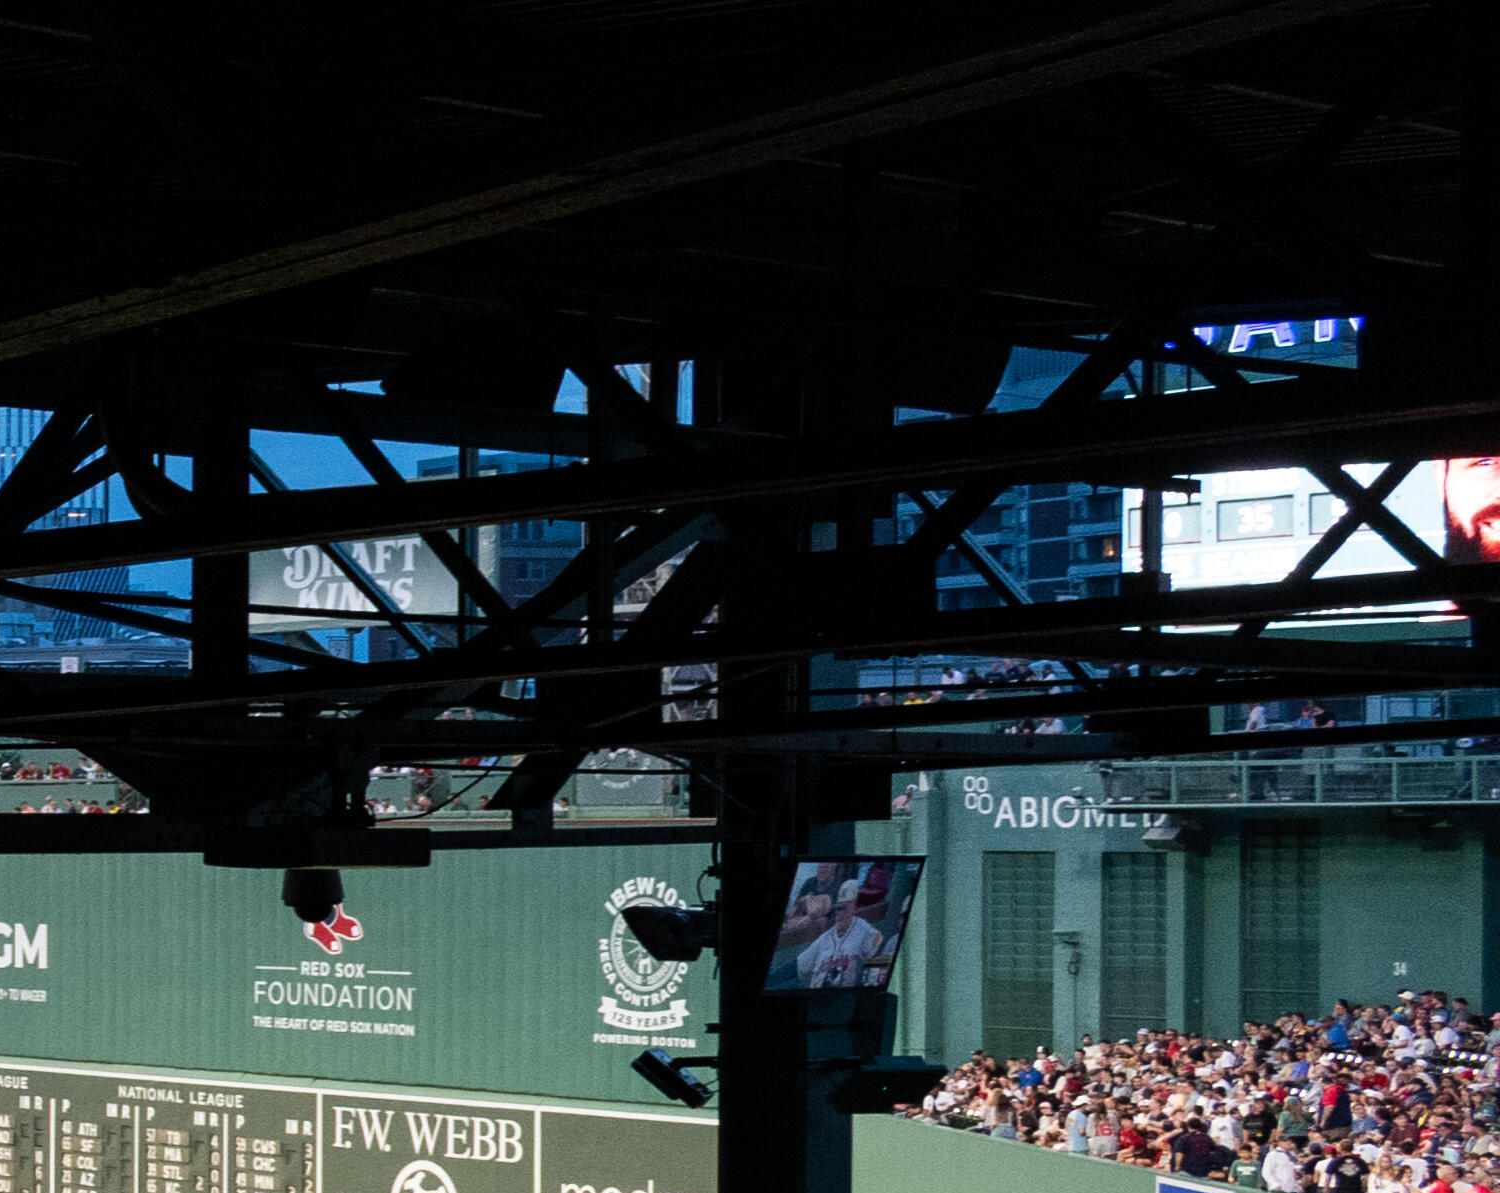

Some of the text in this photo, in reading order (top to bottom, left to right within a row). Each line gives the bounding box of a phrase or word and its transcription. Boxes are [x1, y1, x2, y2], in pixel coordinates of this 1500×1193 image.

[1238, 503, 1273, 534] 35
[300, 961, 366, 979] RED SOX
[599, 938, 618, 986] NECA
[253, 980, 414, 1011] FOUNDATION
[252, 1015, 416, 1037] THE HEART OF RED SOX NATION
[612, 1011, 678, 1028] 125 YEARS
[593, 1033, 697, 1049] POWERING BOSTON
[34, 1096, 43, 1111] R
[117, 1085, 245, 1109] NATIONAL LEAGUE
[61, 1098, 313, 1136] P R P R P R
[77, 1122, 98, 1138] ATH
[403, 1111, 524, 1164] WEBB
[163, 1147, 183, 1163] MIA
[252, 1138, 277, 1155] CWS
[76, 1155, 98, 1172] COL
[252, 1157, 276, 1173] CHC
[163, 1165, 184, 1181] STL
[195, 1175, 205, 1192] 2
[253, 1175, 275, 1191] MIN
